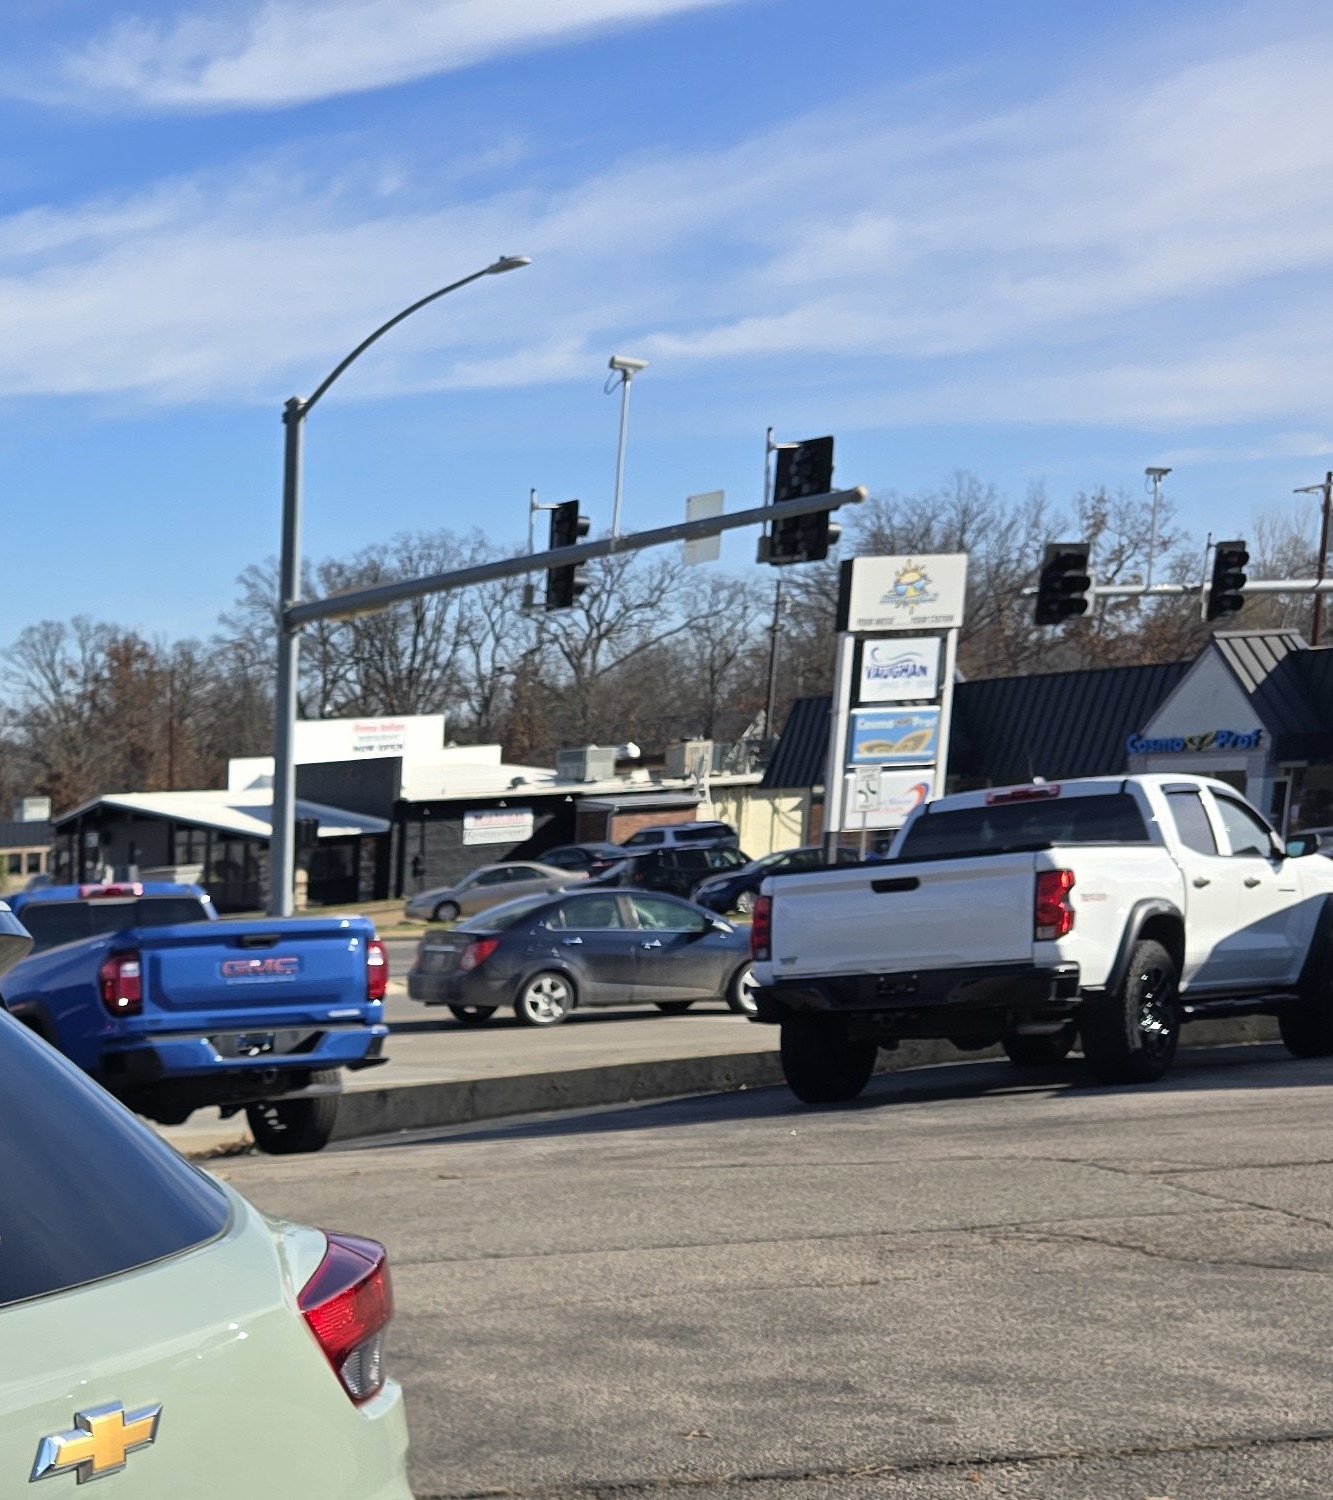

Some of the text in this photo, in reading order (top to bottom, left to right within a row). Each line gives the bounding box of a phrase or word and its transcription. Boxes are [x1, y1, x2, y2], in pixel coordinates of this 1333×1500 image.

[866, 665, 928, 679] VAUGHAN
[1125, 729, 1262, 752] Cosmo Prof
[221, 957, 299, 977] GMC
